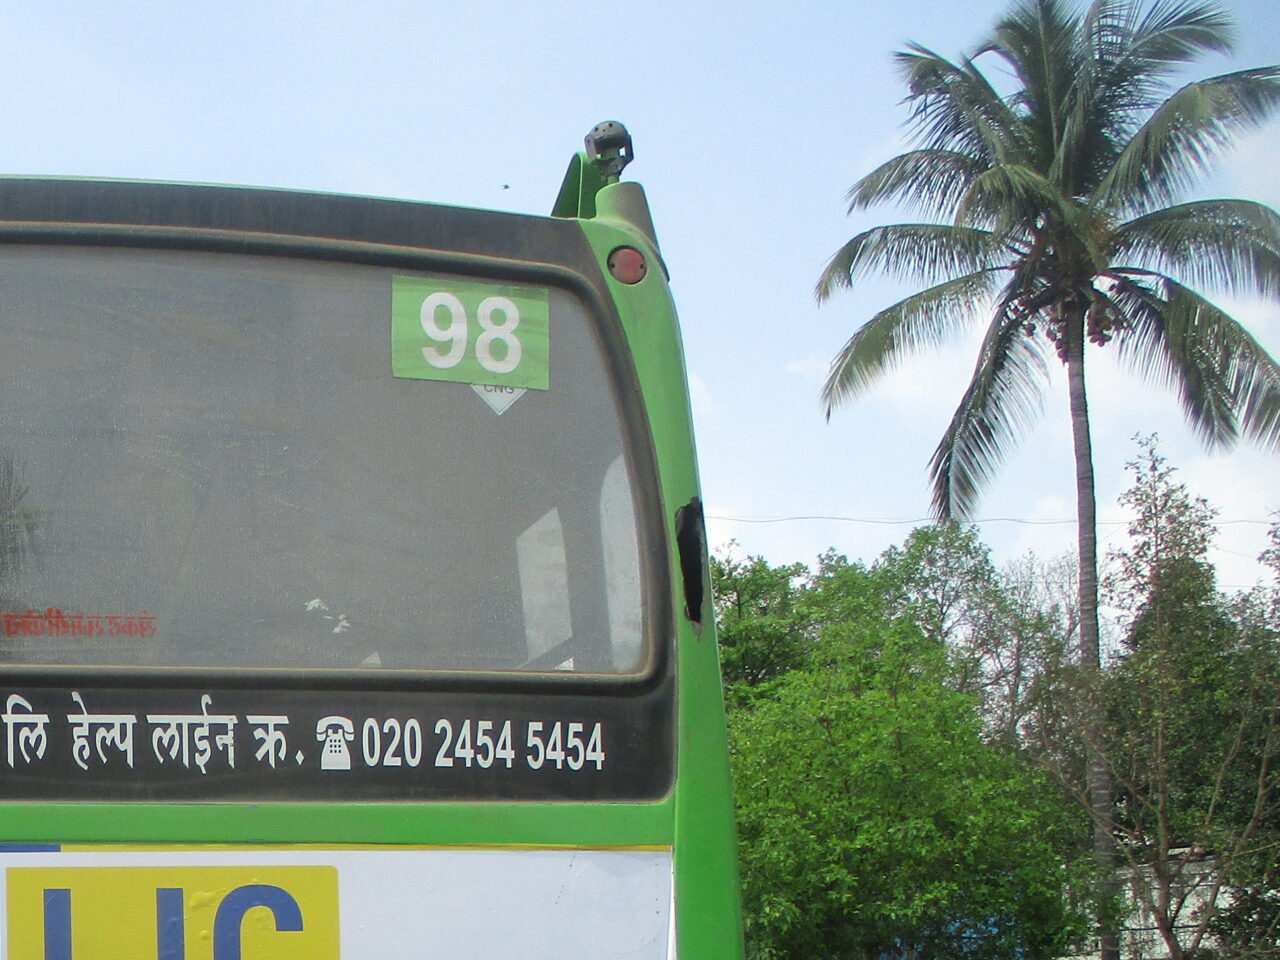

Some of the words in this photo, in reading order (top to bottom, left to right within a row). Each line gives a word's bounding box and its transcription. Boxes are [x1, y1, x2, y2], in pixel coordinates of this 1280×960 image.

[420, 292, 522, 374] 98
[3, 694, 51, 768] लि
[67, 692, 137, 771] हेल्प
[145, 694, 238, 775] लाईन
[247, 714, 303, 768] क्र.
[361, 717, 422, 767] 020
[433, 718, 515, 769] 2454
[526, 720, 605, 771] 5454
